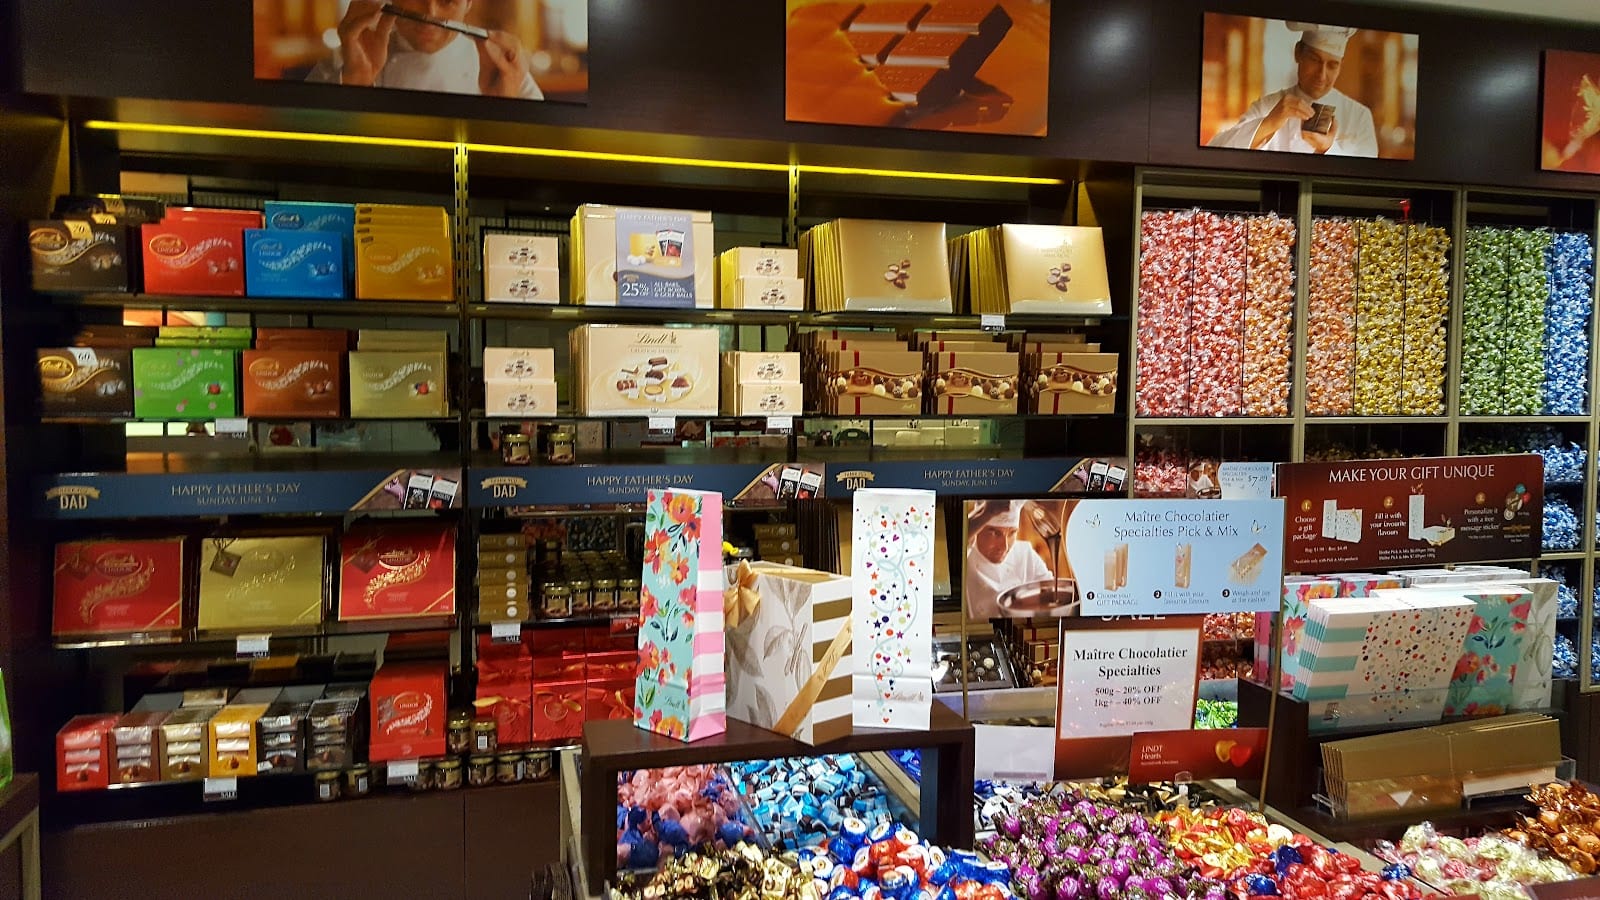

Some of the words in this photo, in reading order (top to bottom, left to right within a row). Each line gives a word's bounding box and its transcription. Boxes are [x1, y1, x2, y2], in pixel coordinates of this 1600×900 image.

[637, 332, 668, 344] Lindt
[924, 470, 953, 479] HAPPY
[956, 469, 996, 479] FATHER'S
[997, 468, 1015, 477] DAY
[1329, 468, 1367, 483] MAKE
[1369, 467, 1407, 481] YOUR
[1410, 466, 1440, 480] GIFT
[1443, 464, 1495, 480] UNIQUE
[587, 475, 622, 487] HAPPY
[624, 474, 671, 486] FATHER'S
[673, 474, 694, 485] DAY
[846, 477, 866, 491] DAD
[971, 479, 988, 487] JUNE
[172, 484, 213, 496] HAPPY
[217, 483, 272, 495] FATHER'S
[276, 482, 301, 494] DAY
[493, 485, 517, 499] DAD
[607, 486, 642, 496] SUNDAY,
[60, 494, 88, 509] DAD
[240, 495, 262, 505] JUNE
[1124, 510, 1161, 523] Maître
[1165, 510, 1230, 522] Chocolatier
[1390, 511, 1402, 519] with
[1464, 507, 1493, 516] Personalize
[1114, 525, 1174, 540] Specialties
[1177, 525, 1201, 537] Pick
[1205, 526, 1213, 537] &
[1217, 525, 1239, 537] Mix
[1303, 524, 1313, 532] gift
[1073, 648, 1115, 661] Maître
[1118, 646, 1188, 660] Chocolatier
[1098, 665, 1161, 680] Specialties
[1095, 687, 1114, 697] 500g
[1123, 686, 1141, 695] 20%
[1143, 685, 1162, 694] OFF
[1122, 697, 1141, 706] 40%
[1143, 696, 1162, 705] OFF
[1141, 744, 1163, 753] LINDT
